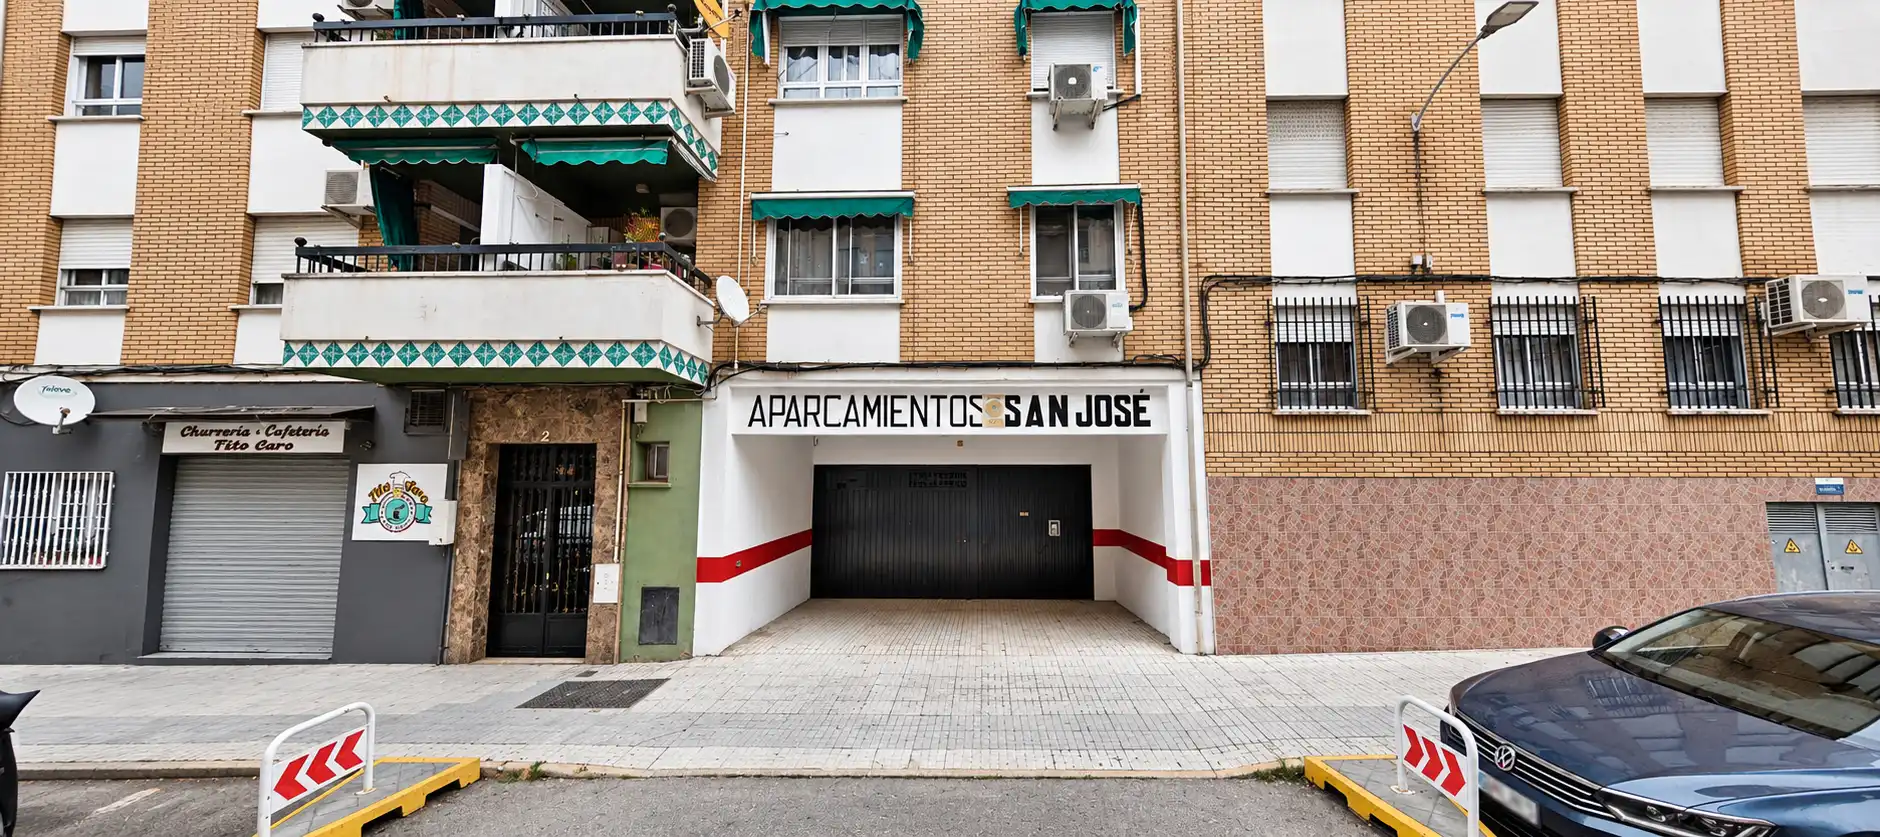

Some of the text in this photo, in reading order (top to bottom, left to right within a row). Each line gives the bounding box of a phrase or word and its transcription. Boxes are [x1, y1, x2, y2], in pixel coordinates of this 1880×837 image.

[747, 388, 1152, 428] APARCAMIENTOS SAN JOSÉ
[540, 430, 550, 442] 2
[214, 439, 294, 451] Fito Caro
